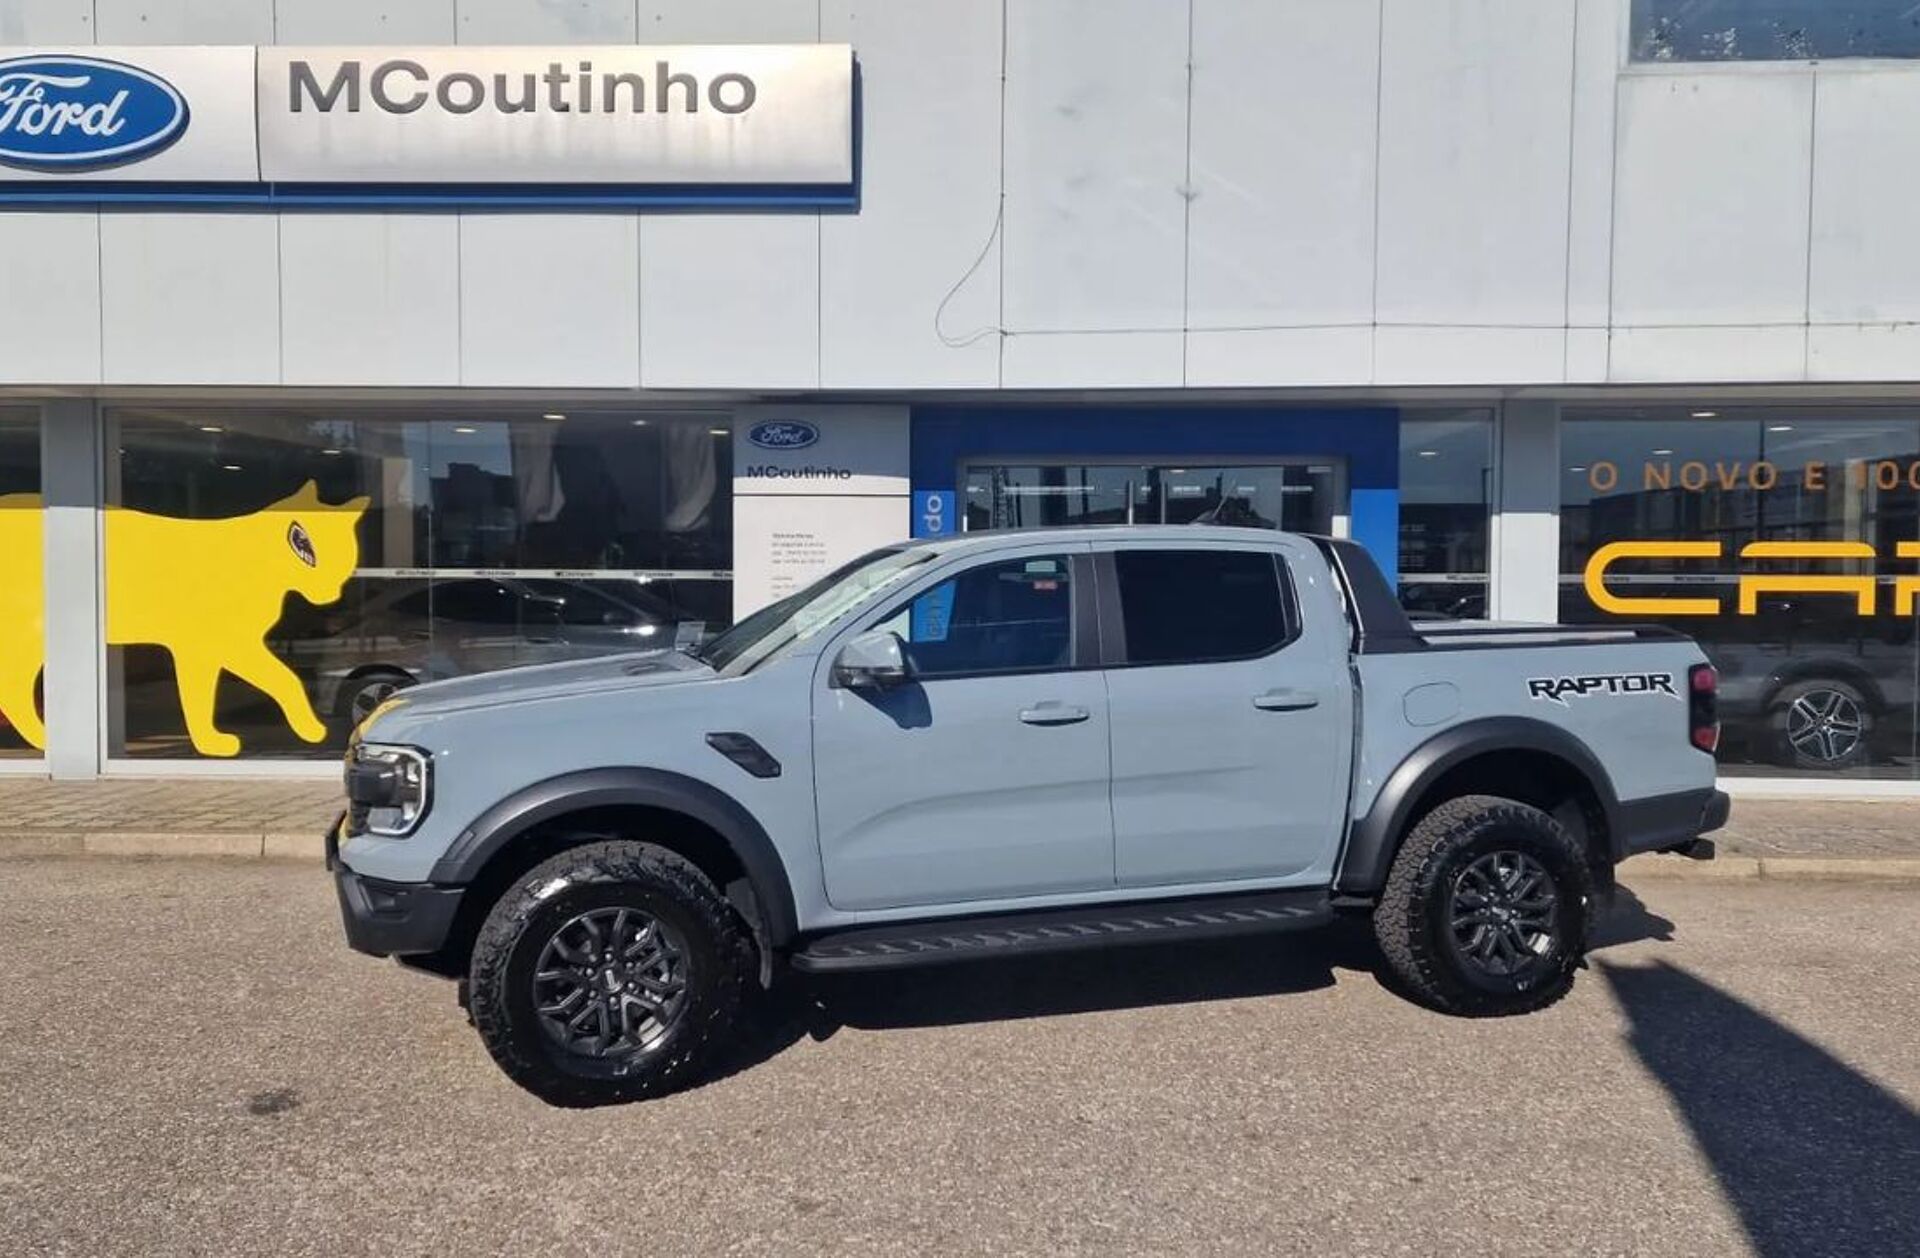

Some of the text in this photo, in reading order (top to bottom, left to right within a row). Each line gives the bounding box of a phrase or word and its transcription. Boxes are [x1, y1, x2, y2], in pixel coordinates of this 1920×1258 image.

[0, 60, 758, 136] Ford MCoutinho
[760, 423, 804, 444] Ford
[747, 465, 852, 481] MCoutinho
[1589, 460, 1618, 491] O
[1644, 460, 1777, 491] NOVO
[1805, 460, 1826, 491] E
[1584, 541, 1920, 616] CA
[1527, 673, 1680, 705] RAPTOR
